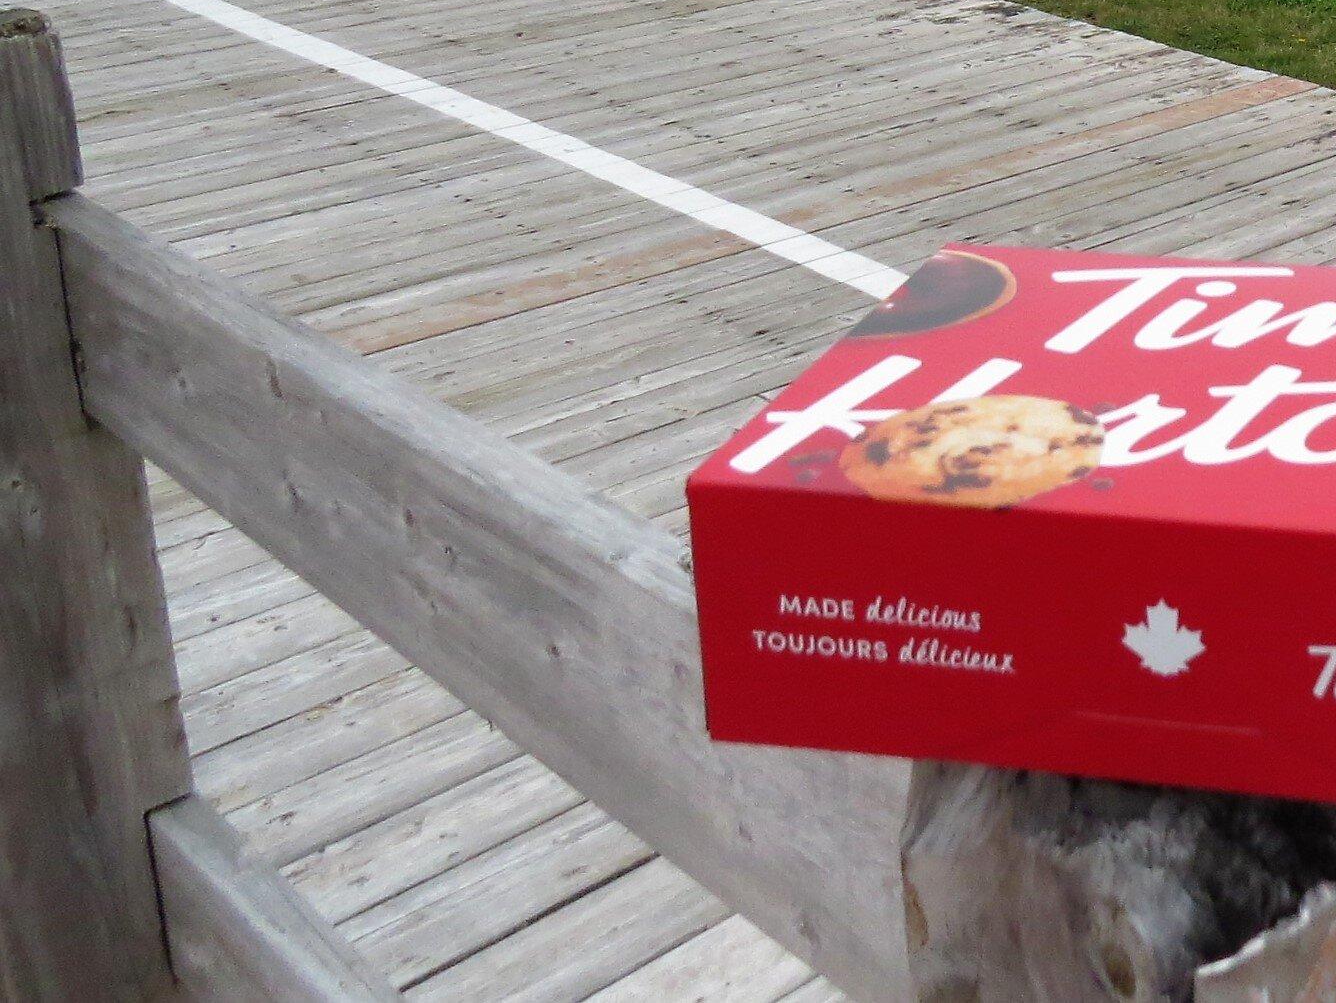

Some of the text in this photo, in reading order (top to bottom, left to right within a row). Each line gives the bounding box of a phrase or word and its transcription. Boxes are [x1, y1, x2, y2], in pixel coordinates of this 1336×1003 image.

[778, 594, 982, 633] MADE delicious
[752, 629, 1016, 674] TOUJOURS délicieux
